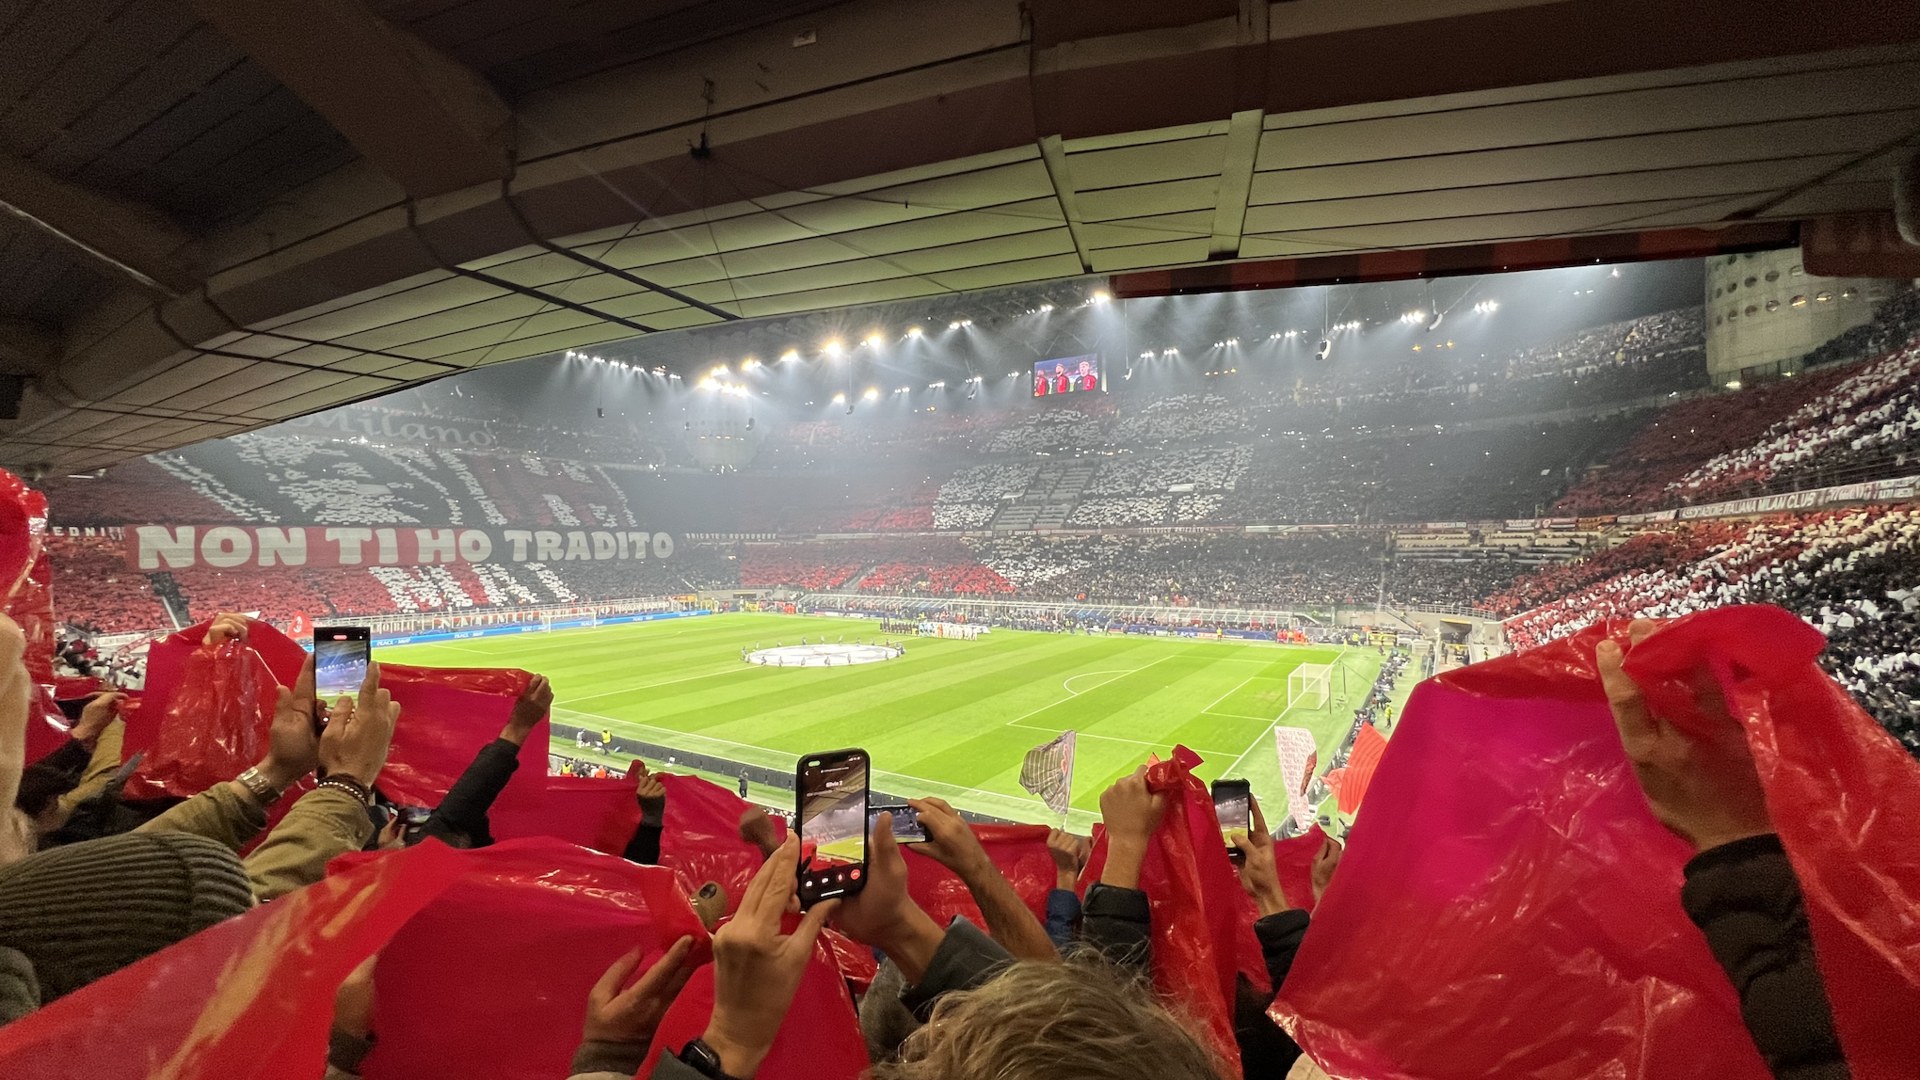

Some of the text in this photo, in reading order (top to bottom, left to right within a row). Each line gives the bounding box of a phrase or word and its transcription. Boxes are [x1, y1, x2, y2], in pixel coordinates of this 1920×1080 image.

[1757, 495, 1786, 511] MILAN
[1787, 491, 1817, 509] CLUB
[136, 526, 674, 569] NON TI HO TRADITO
